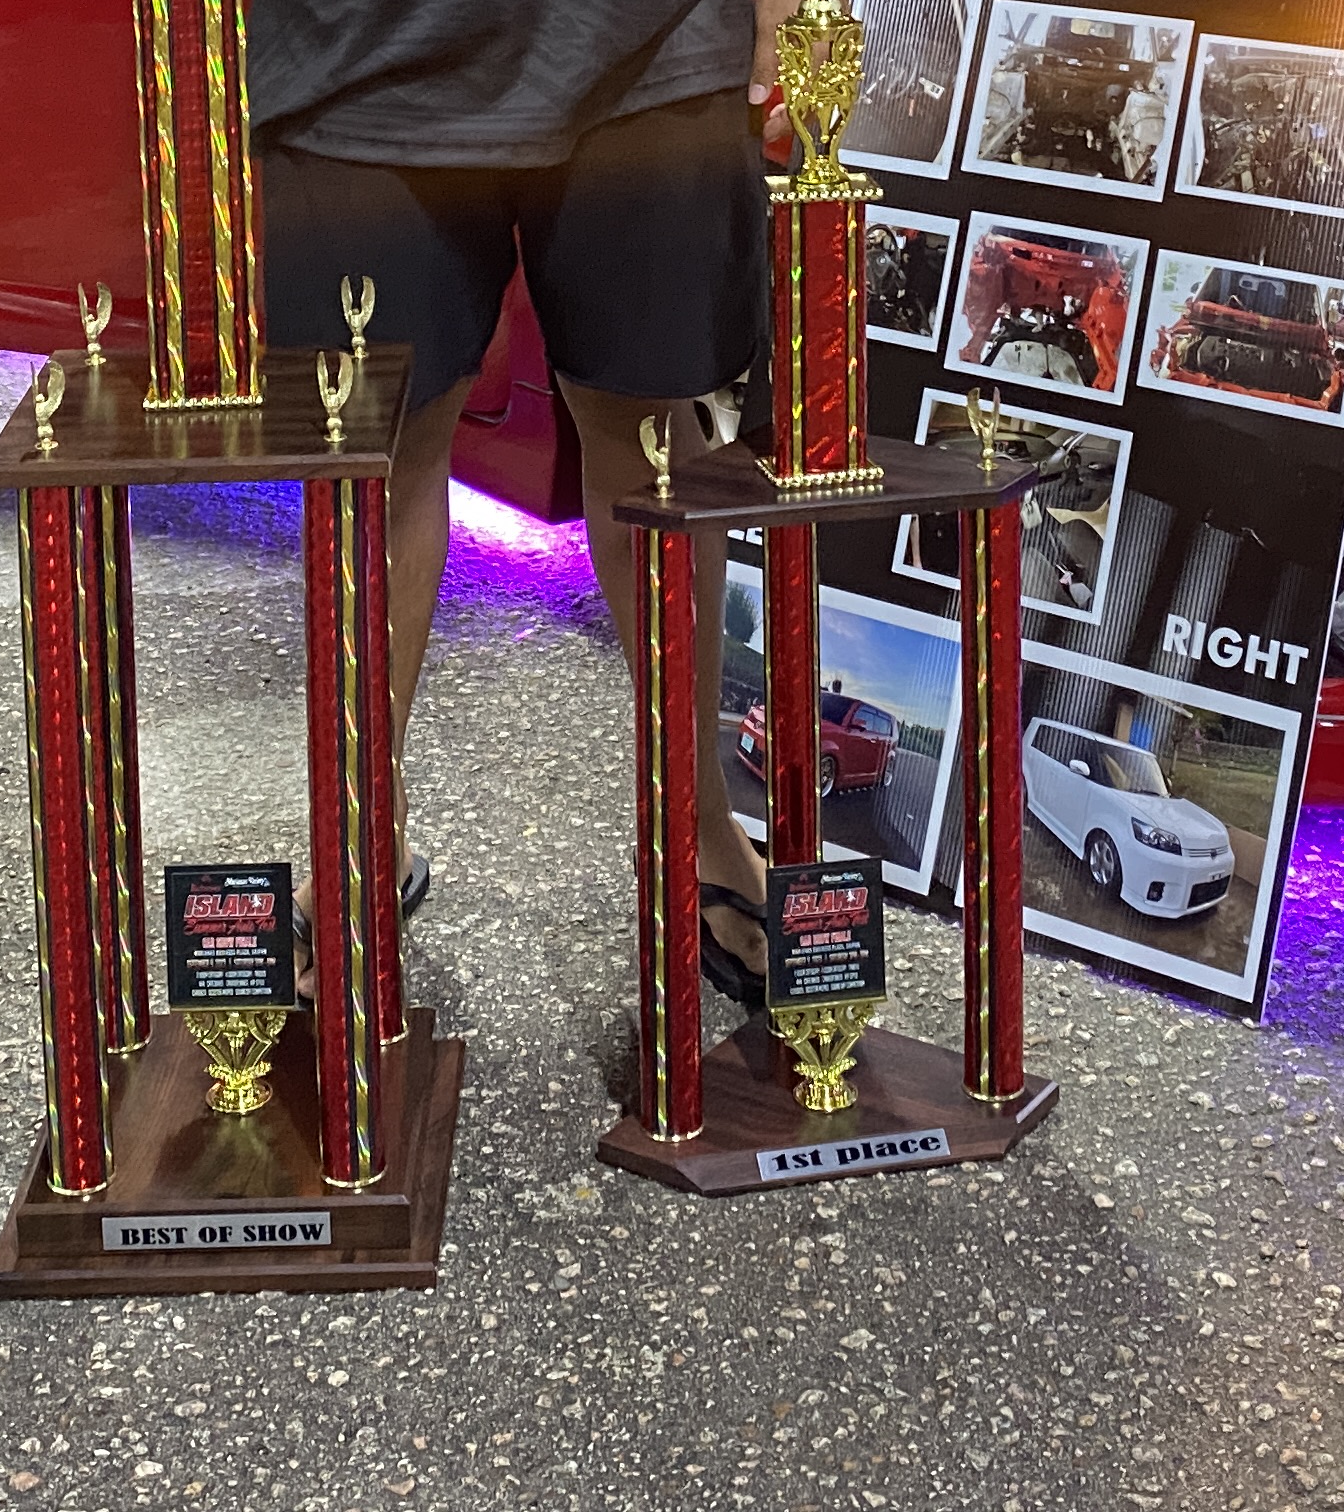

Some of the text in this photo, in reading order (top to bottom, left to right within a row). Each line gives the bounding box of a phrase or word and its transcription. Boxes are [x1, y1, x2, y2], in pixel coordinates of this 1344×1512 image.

[1162, 612, 1309, 685] RIGHT
[183, 893, 275, 918] ISLAND
[782, 887, 868, 918] ISLAND
[772, 1136, 941, 1171] 1st place
[121, 1223, 324, 1245] BEST OF SHOW
